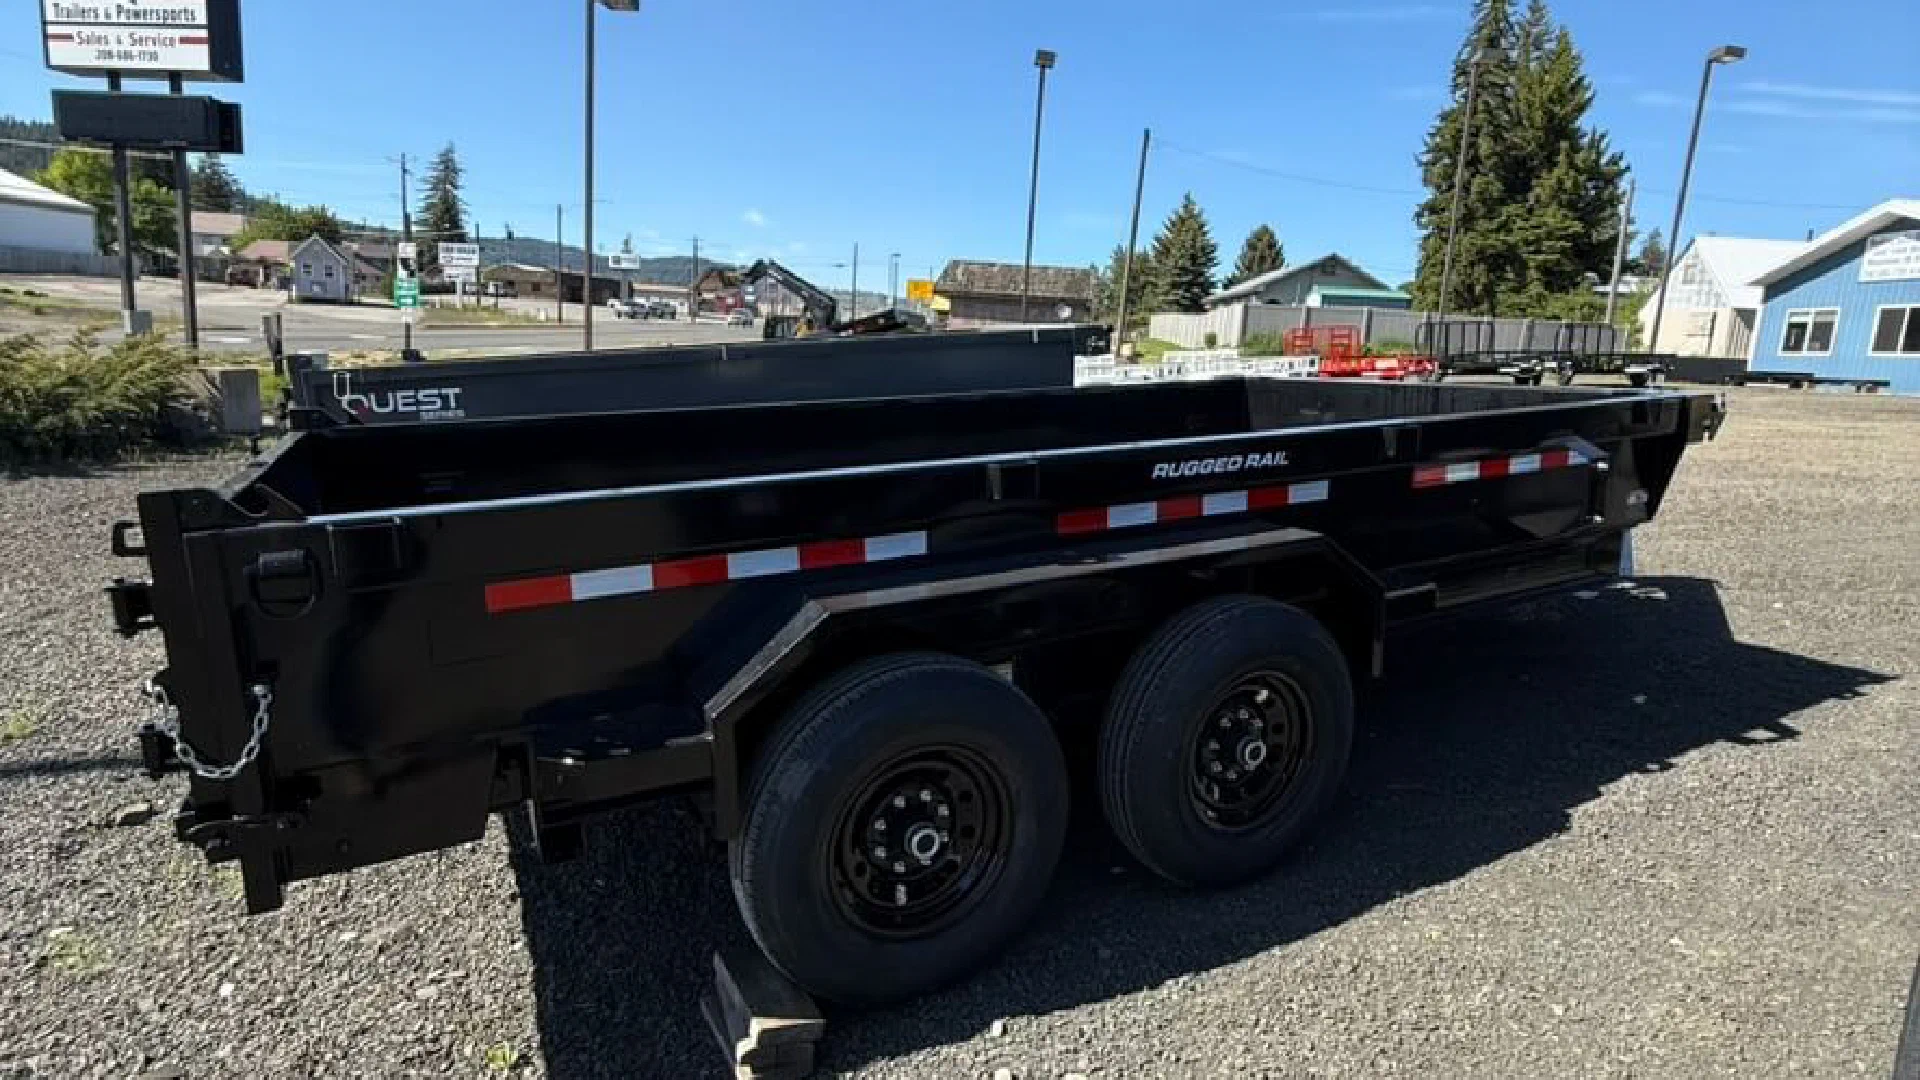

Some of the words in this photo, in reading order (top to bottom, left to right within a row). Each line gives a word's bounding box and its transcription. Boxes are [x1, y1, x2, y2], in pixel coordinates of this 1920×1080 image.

[52, 2, 99, 20] Trailers
[104, 6, 112, 20] &
[116, 4, 197, 24] Powersports
[75, 30, 109, 46] Sales
[116, 34, 123, 45] &
[129, 32, 176, 48] Service
[1151, 455, 1243, 479] RUGGED
[1243, 451, 1289, 469] RAIL
